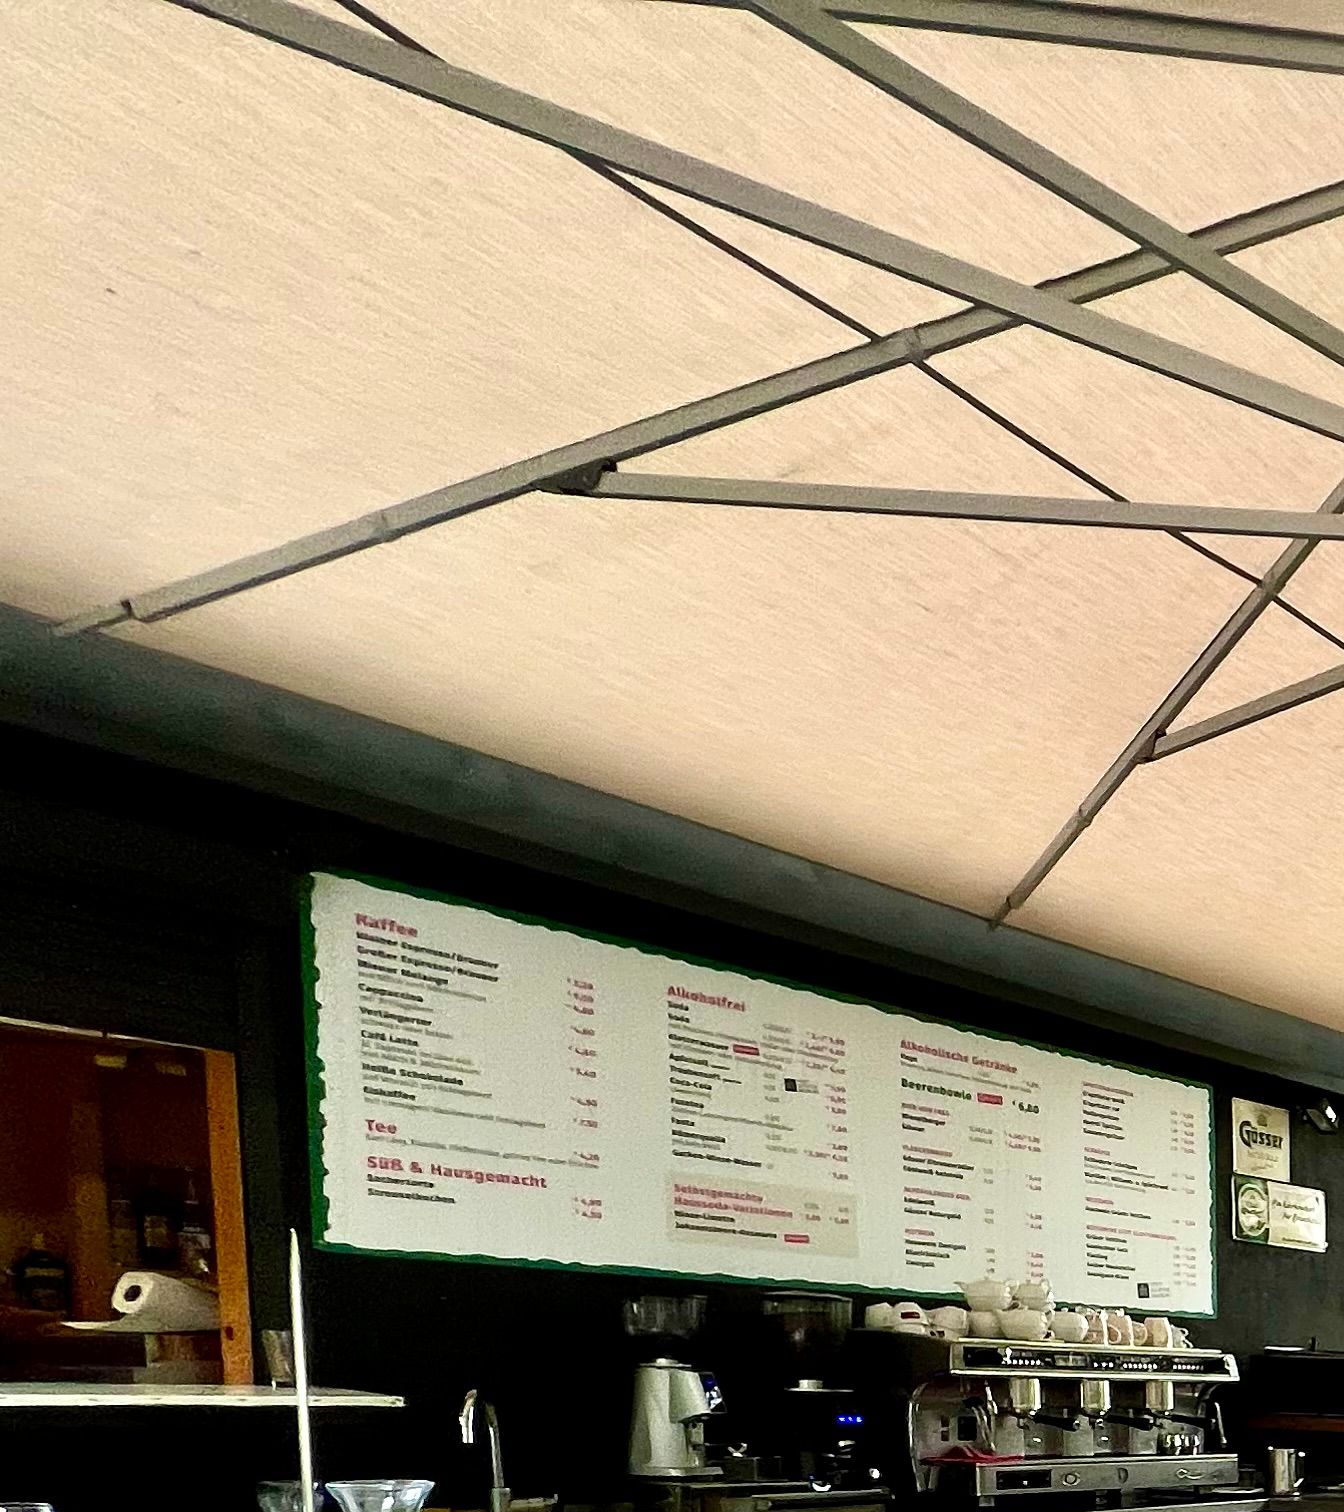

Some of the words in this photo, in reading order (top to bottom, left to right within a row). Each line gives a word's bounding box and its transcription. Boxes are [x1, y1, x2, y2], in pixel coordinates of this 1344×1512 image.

[355, 912, 418, 938] Kaffee
[667, 983, 745, 1012] Alkoholfrei
[900, 1039, 968, 1063] Alkoholische
[971, 1055, 1017, 1074] Getränke
[901, 1077, 971, 1101] Beerenbowle
[365, 1118, 397, 1134] Tee
[367, 1155, 403, 1171] Süß
[409, 1161, 422, 1173] &
[431, 1163, 547, 1191] Hausgemacht
